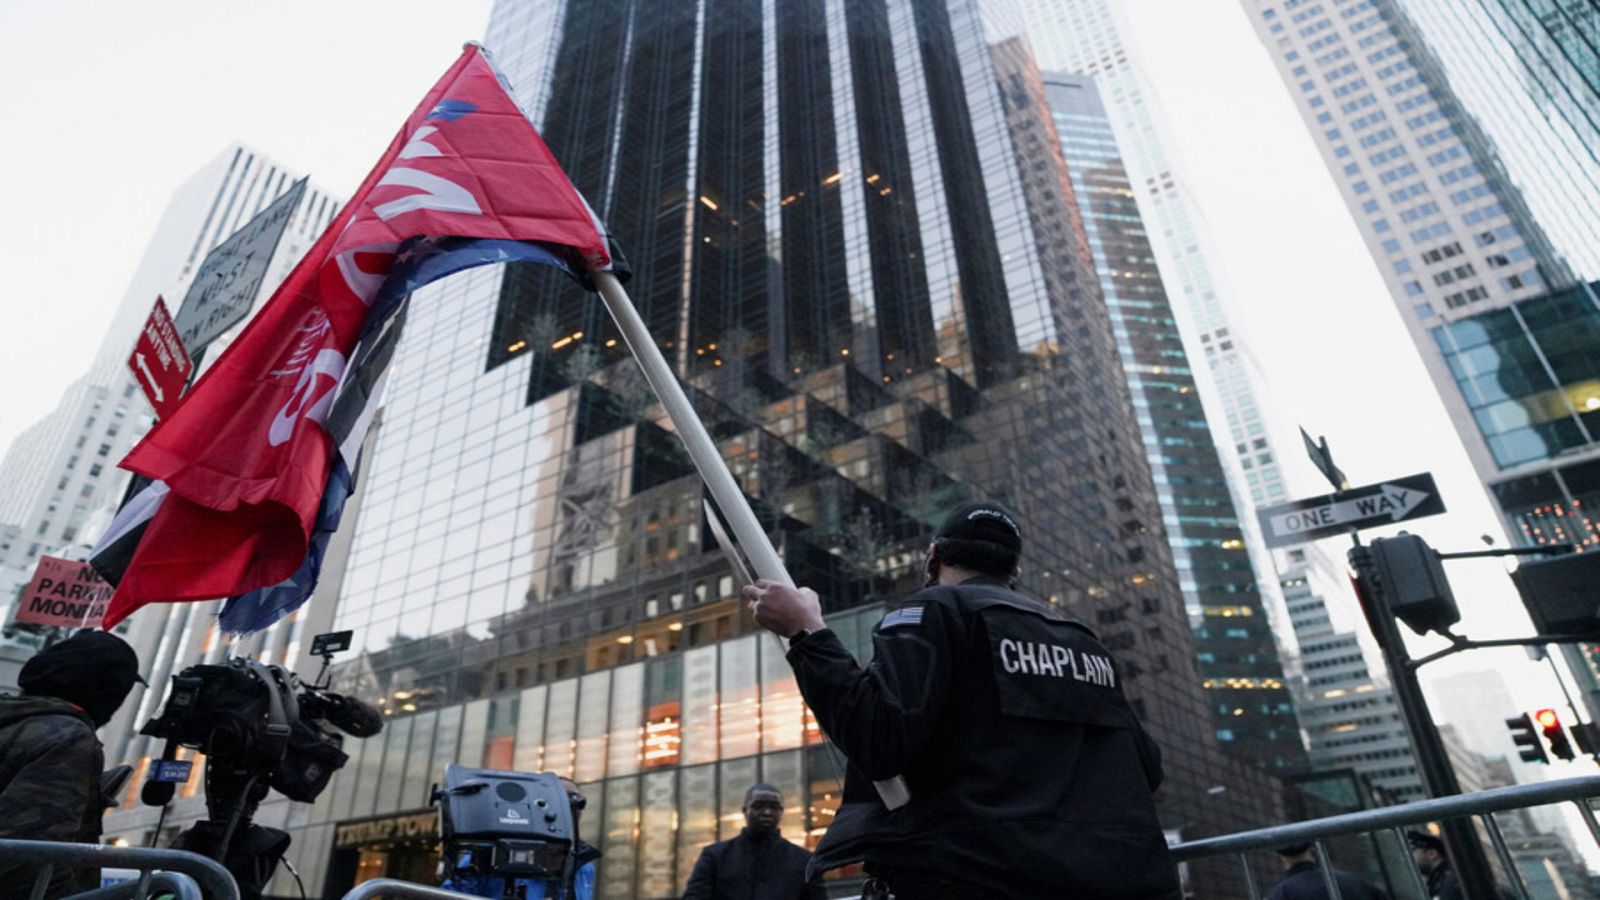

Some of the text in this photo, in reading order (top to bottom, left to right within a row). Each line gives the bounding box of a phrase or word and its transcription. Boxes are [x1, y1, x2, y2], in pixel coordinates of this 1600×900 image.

[196, 251, 256, 311] MUST
[1285, 491, 1409, 531] ONE WAY
[37, 578, 113, 599] PARKIN
[29, 597, 105, 619] MONDA
[1000, 638, 1115, 688] CHAPLAIN
[397, 811, 440, 836] TOW
